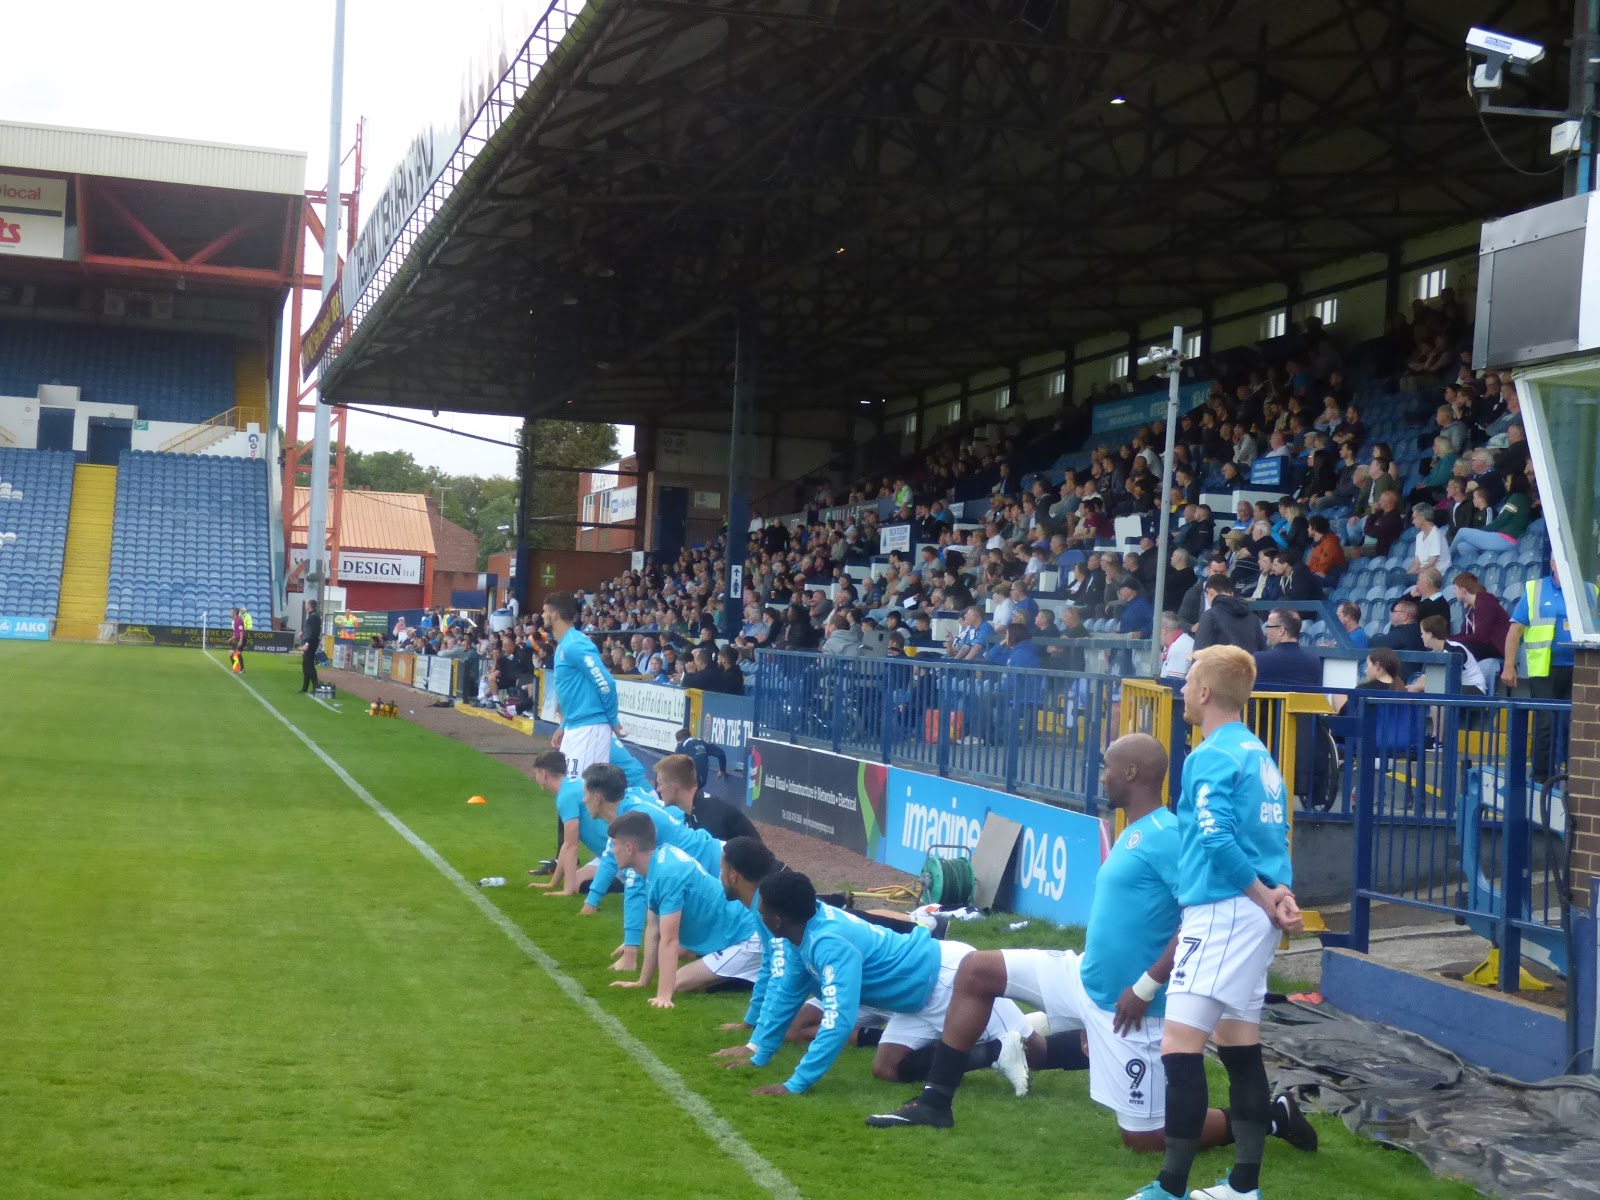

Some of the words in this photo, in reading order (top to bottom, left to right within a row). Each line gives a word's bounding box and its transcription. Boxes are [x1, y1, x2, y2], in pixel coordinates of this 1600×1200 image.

[343, 560, 402, 576] DESIGN
[14, 622, 46, 632] JAKO
[711, 717, 725, 745] FOR
[726, 719, 741, 747] THE
[1177, 936, 1202, 968] 7
[1125, 1058, 1146, 1089] 9
